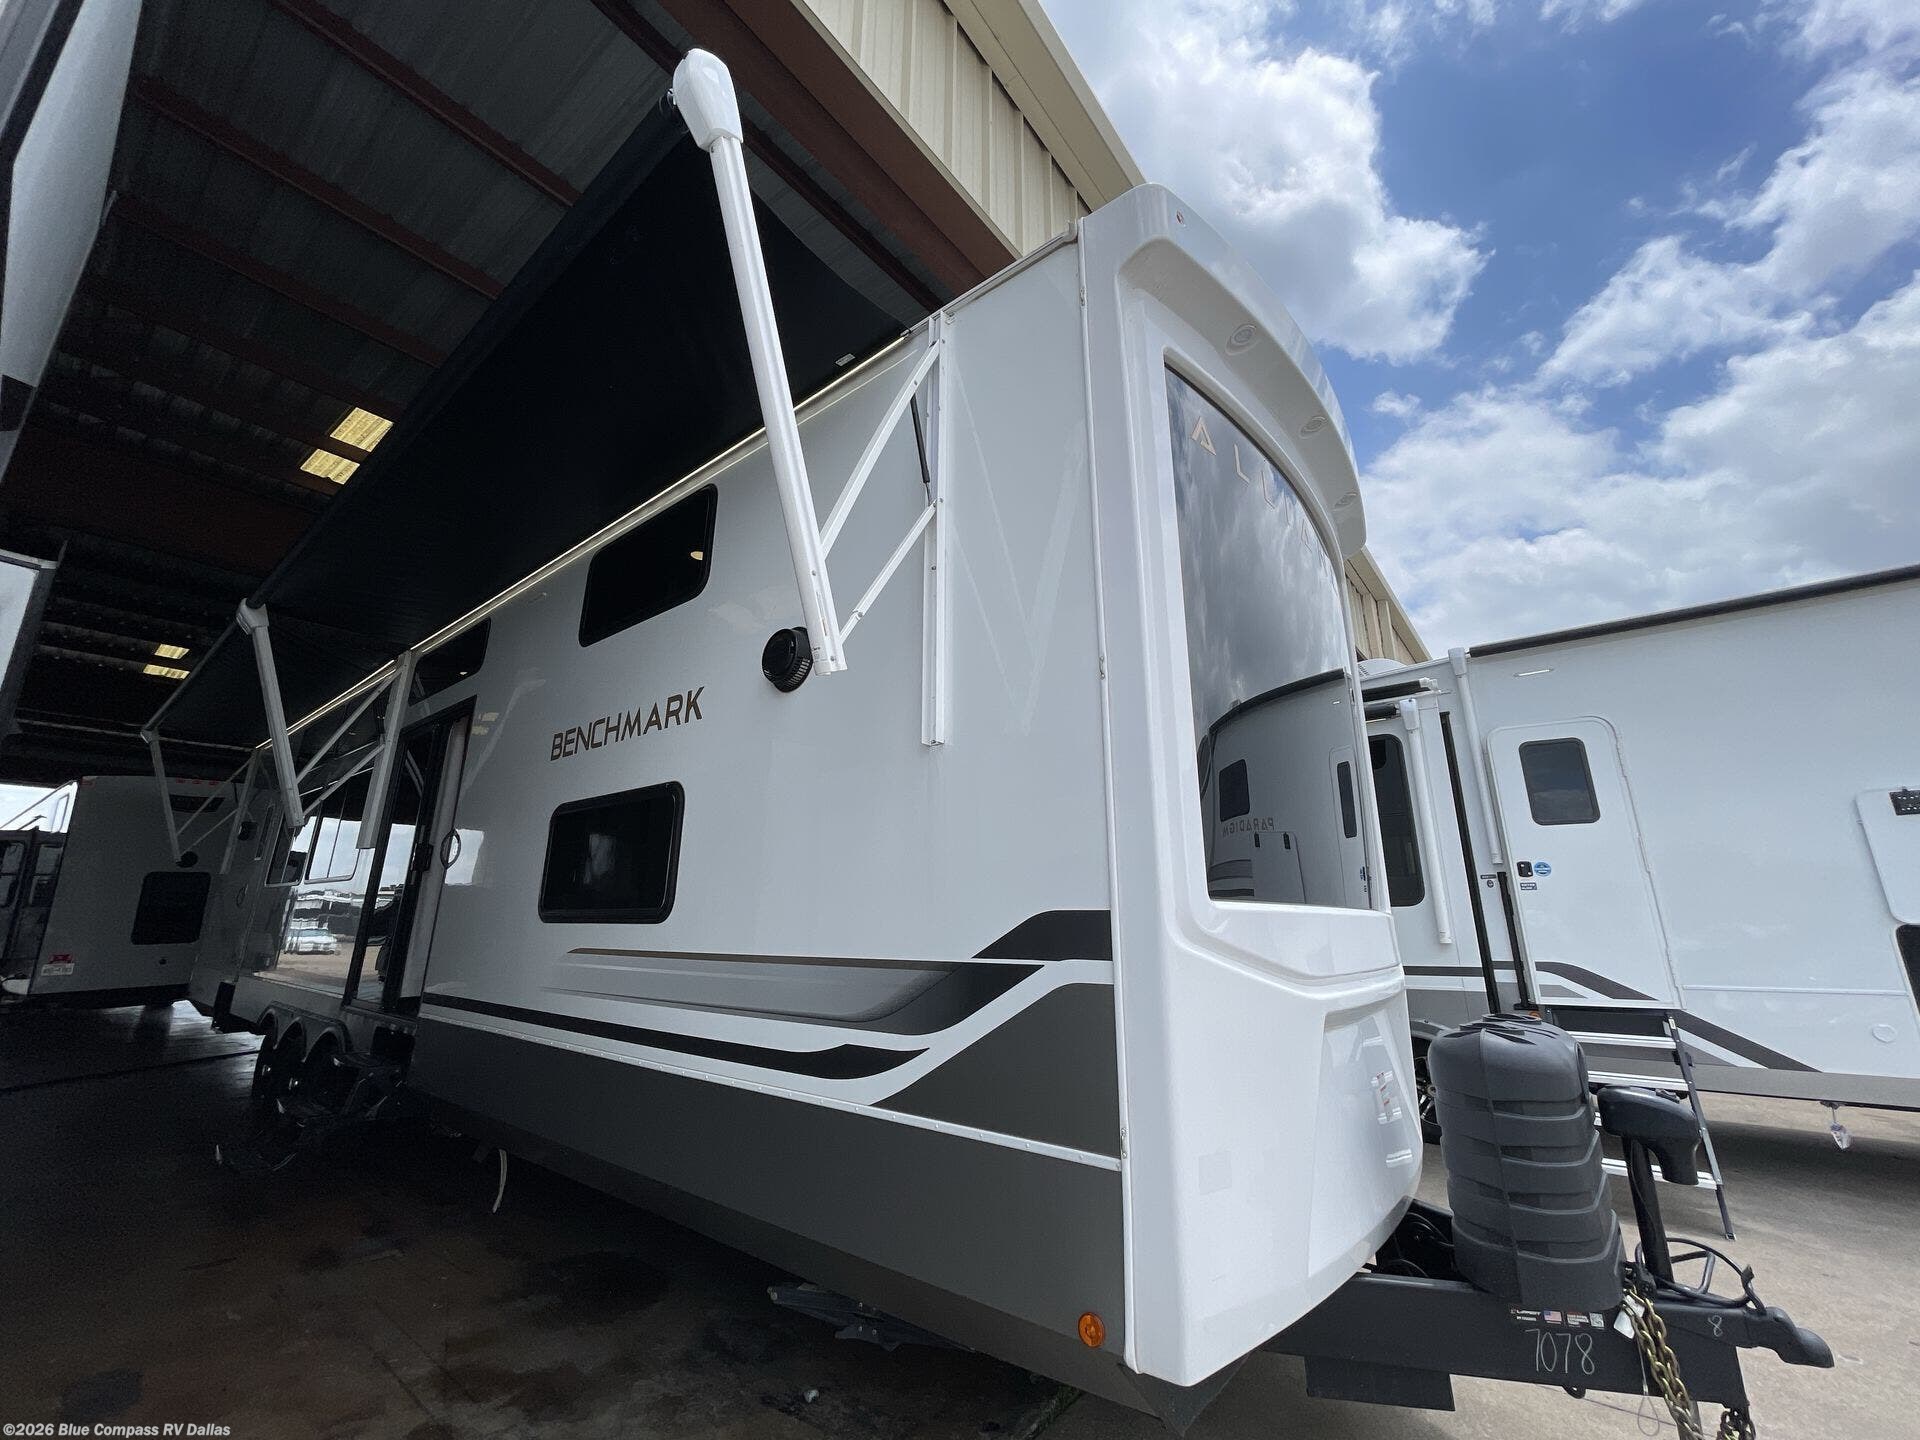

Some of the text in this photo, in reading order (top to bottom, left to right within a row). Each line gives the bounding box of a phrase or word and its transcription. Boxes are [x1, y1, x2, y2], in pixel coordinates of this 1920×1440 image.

[550, 686, 705, 761] BENCHMARK
[1707, 1314, 1723, 1338] 8
[1525, 1328, 1596, 1375] 7078
